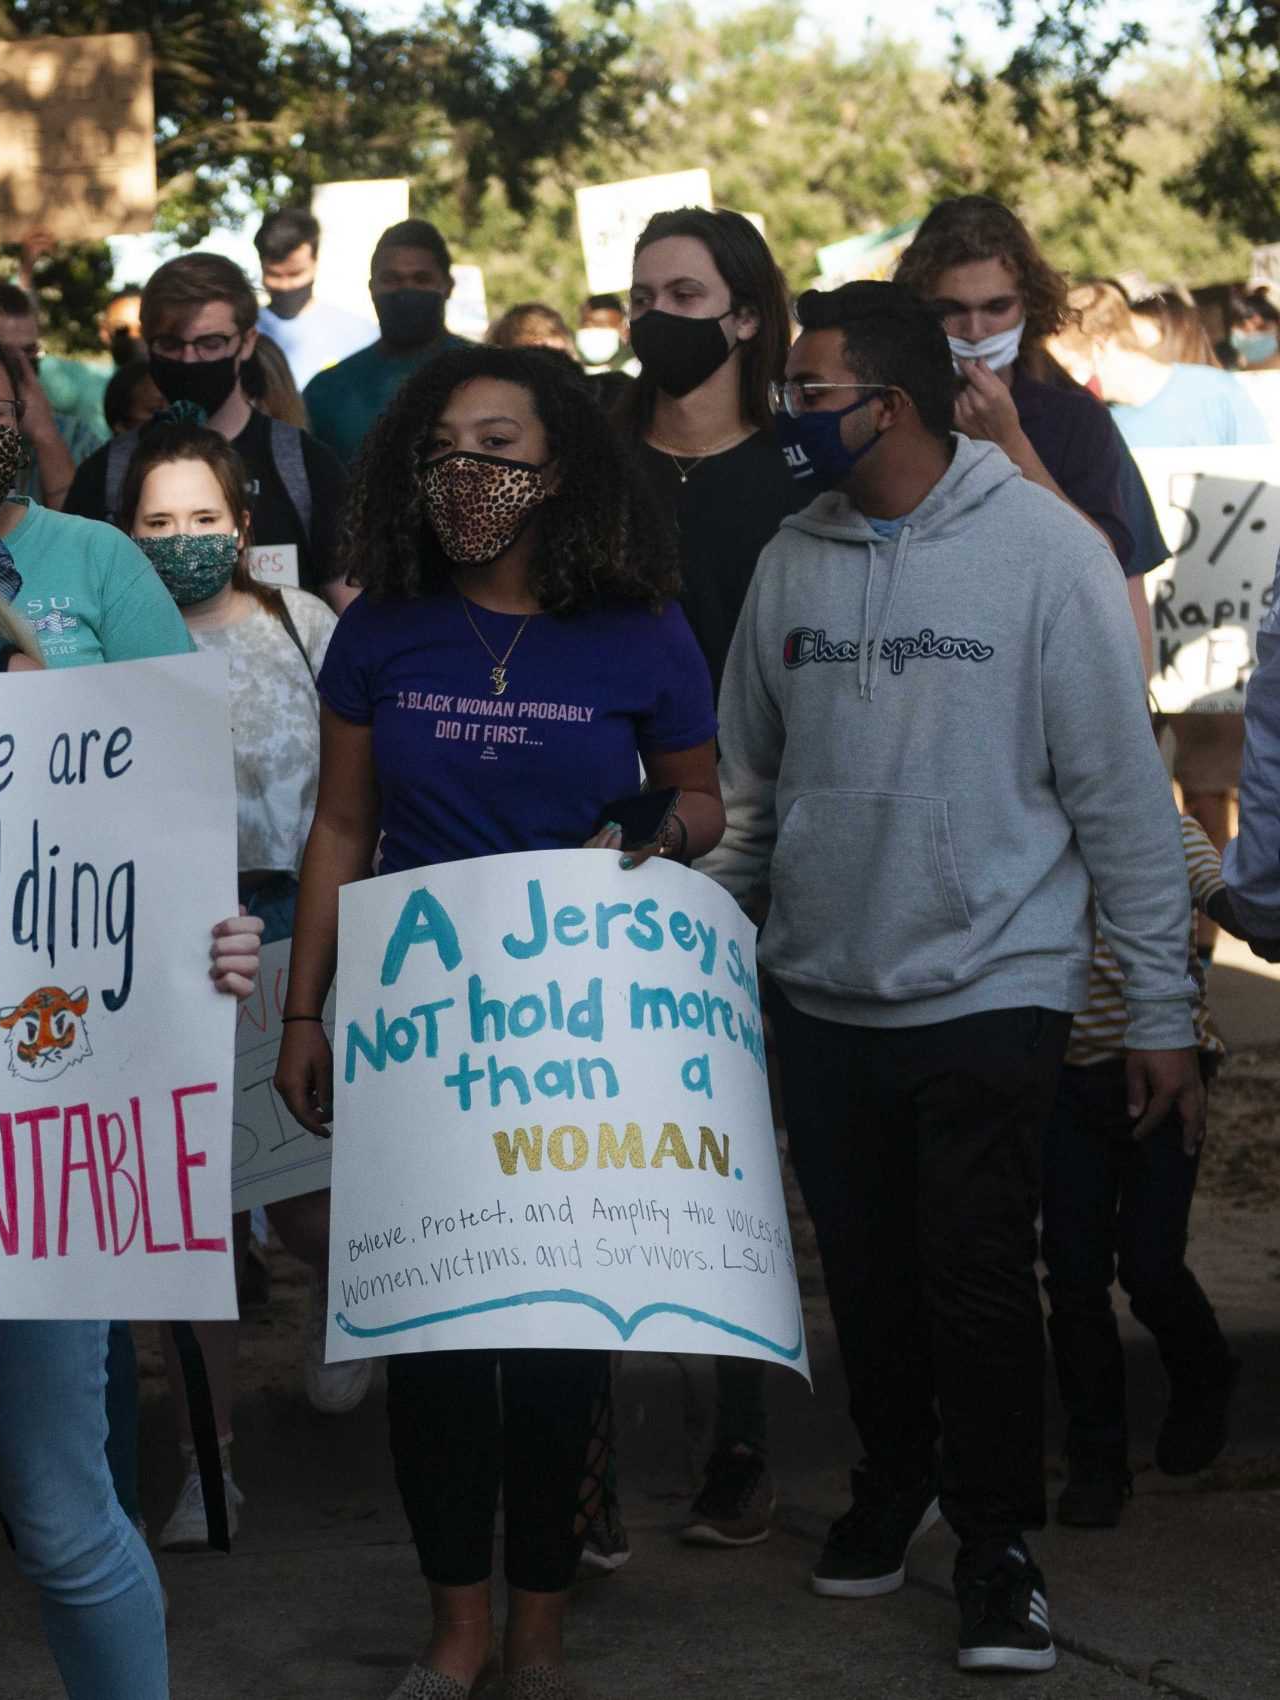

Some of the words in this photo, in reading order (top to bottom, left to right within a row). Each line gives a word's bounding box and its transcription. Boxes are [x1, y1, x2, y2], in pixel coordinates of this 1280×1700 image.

[396, 691, 406, 709] A
[407, 691, 455, 713] BLACK
[456, 697, 515, 717] WOMAN
[518, 702, 594, 722] PROBABLY
[435, 719, 461, 740] DID
[464, 723, 481, 742] IT
[49, 725, 135, 786] are
[381, 886, 463, 987] A
[502, 879, 718, 975] Jersey
[468, 973, 604, 1044] hold
[630, 981, 738, 1042] more
[444, 1052, 620, 1112] than
[681, 1054, 713, 1099] a
[493, 1121, 744, 1181] WOMAN.
[524, 1195, 575, 1225] and
[592, 1197, 671, 1236] Amplify
[683, 1199, 719, 1225] the
[535, 1238, 583, 1269] and
